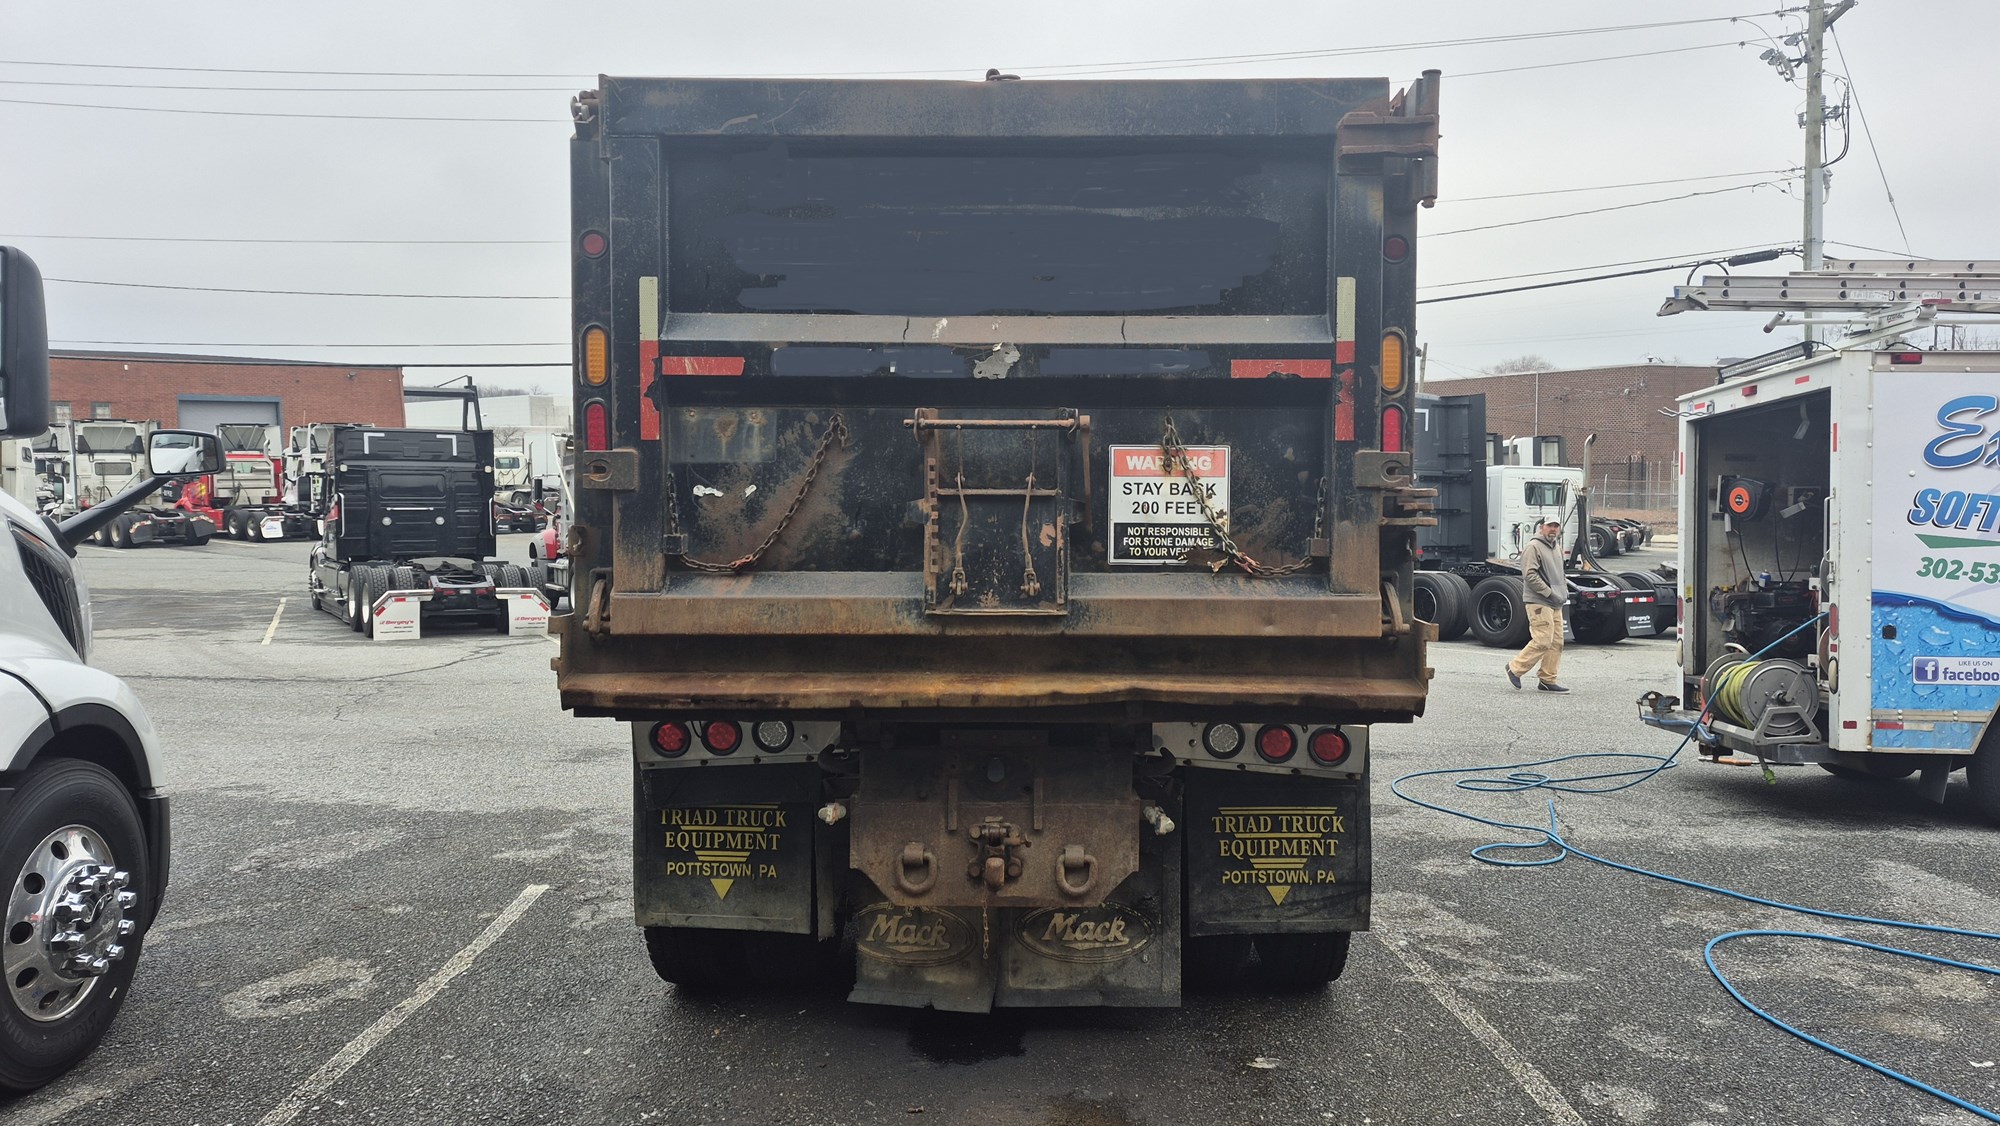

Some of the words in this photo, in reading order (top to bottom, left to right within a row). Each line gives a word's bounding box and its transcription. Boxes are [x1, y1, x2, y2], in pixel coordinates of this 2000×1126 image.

[1126, 455, 1212, 471] WARING
[1122, 482, 1164, 496] STAY
[1132, 501, 1159, 515] 200
[1127, 527, 1146, 536] NOT
[1148, 527, 1210, 536] RESPONSIBLE
[1123, 537, 1142, 546] FOR
[1143, 537, 1173, 546] STONE
[1175, 537, 1214, 547] DAMAGE
[1129, 547, 1142, 556] TO
[1143, 547, 1168, 556] YOUR
[1916, 556, 2000, 584] 302-53
[660, 808, 717, 825] TRIAD
[724, 809, 787, 828] TRUCK
[1211, 816, 1272, 833] TRIAD
[1278, 815, 1345, 833] TRUCK
[665, 831, 781, 851] EQUIPMENT
[1219, 839, 1339, 860] EQUIPMENT
[666, 861, 755, 879] POTTSTOWN,
[759, 864, 777, 878] PA
[1222, 869, 1313, 885] POTTSTOWN,
[1316, 869, 1336, 884] PA
[865, 913, 950, 946] Mack
[1041, 912, 1130, 944] Mack
